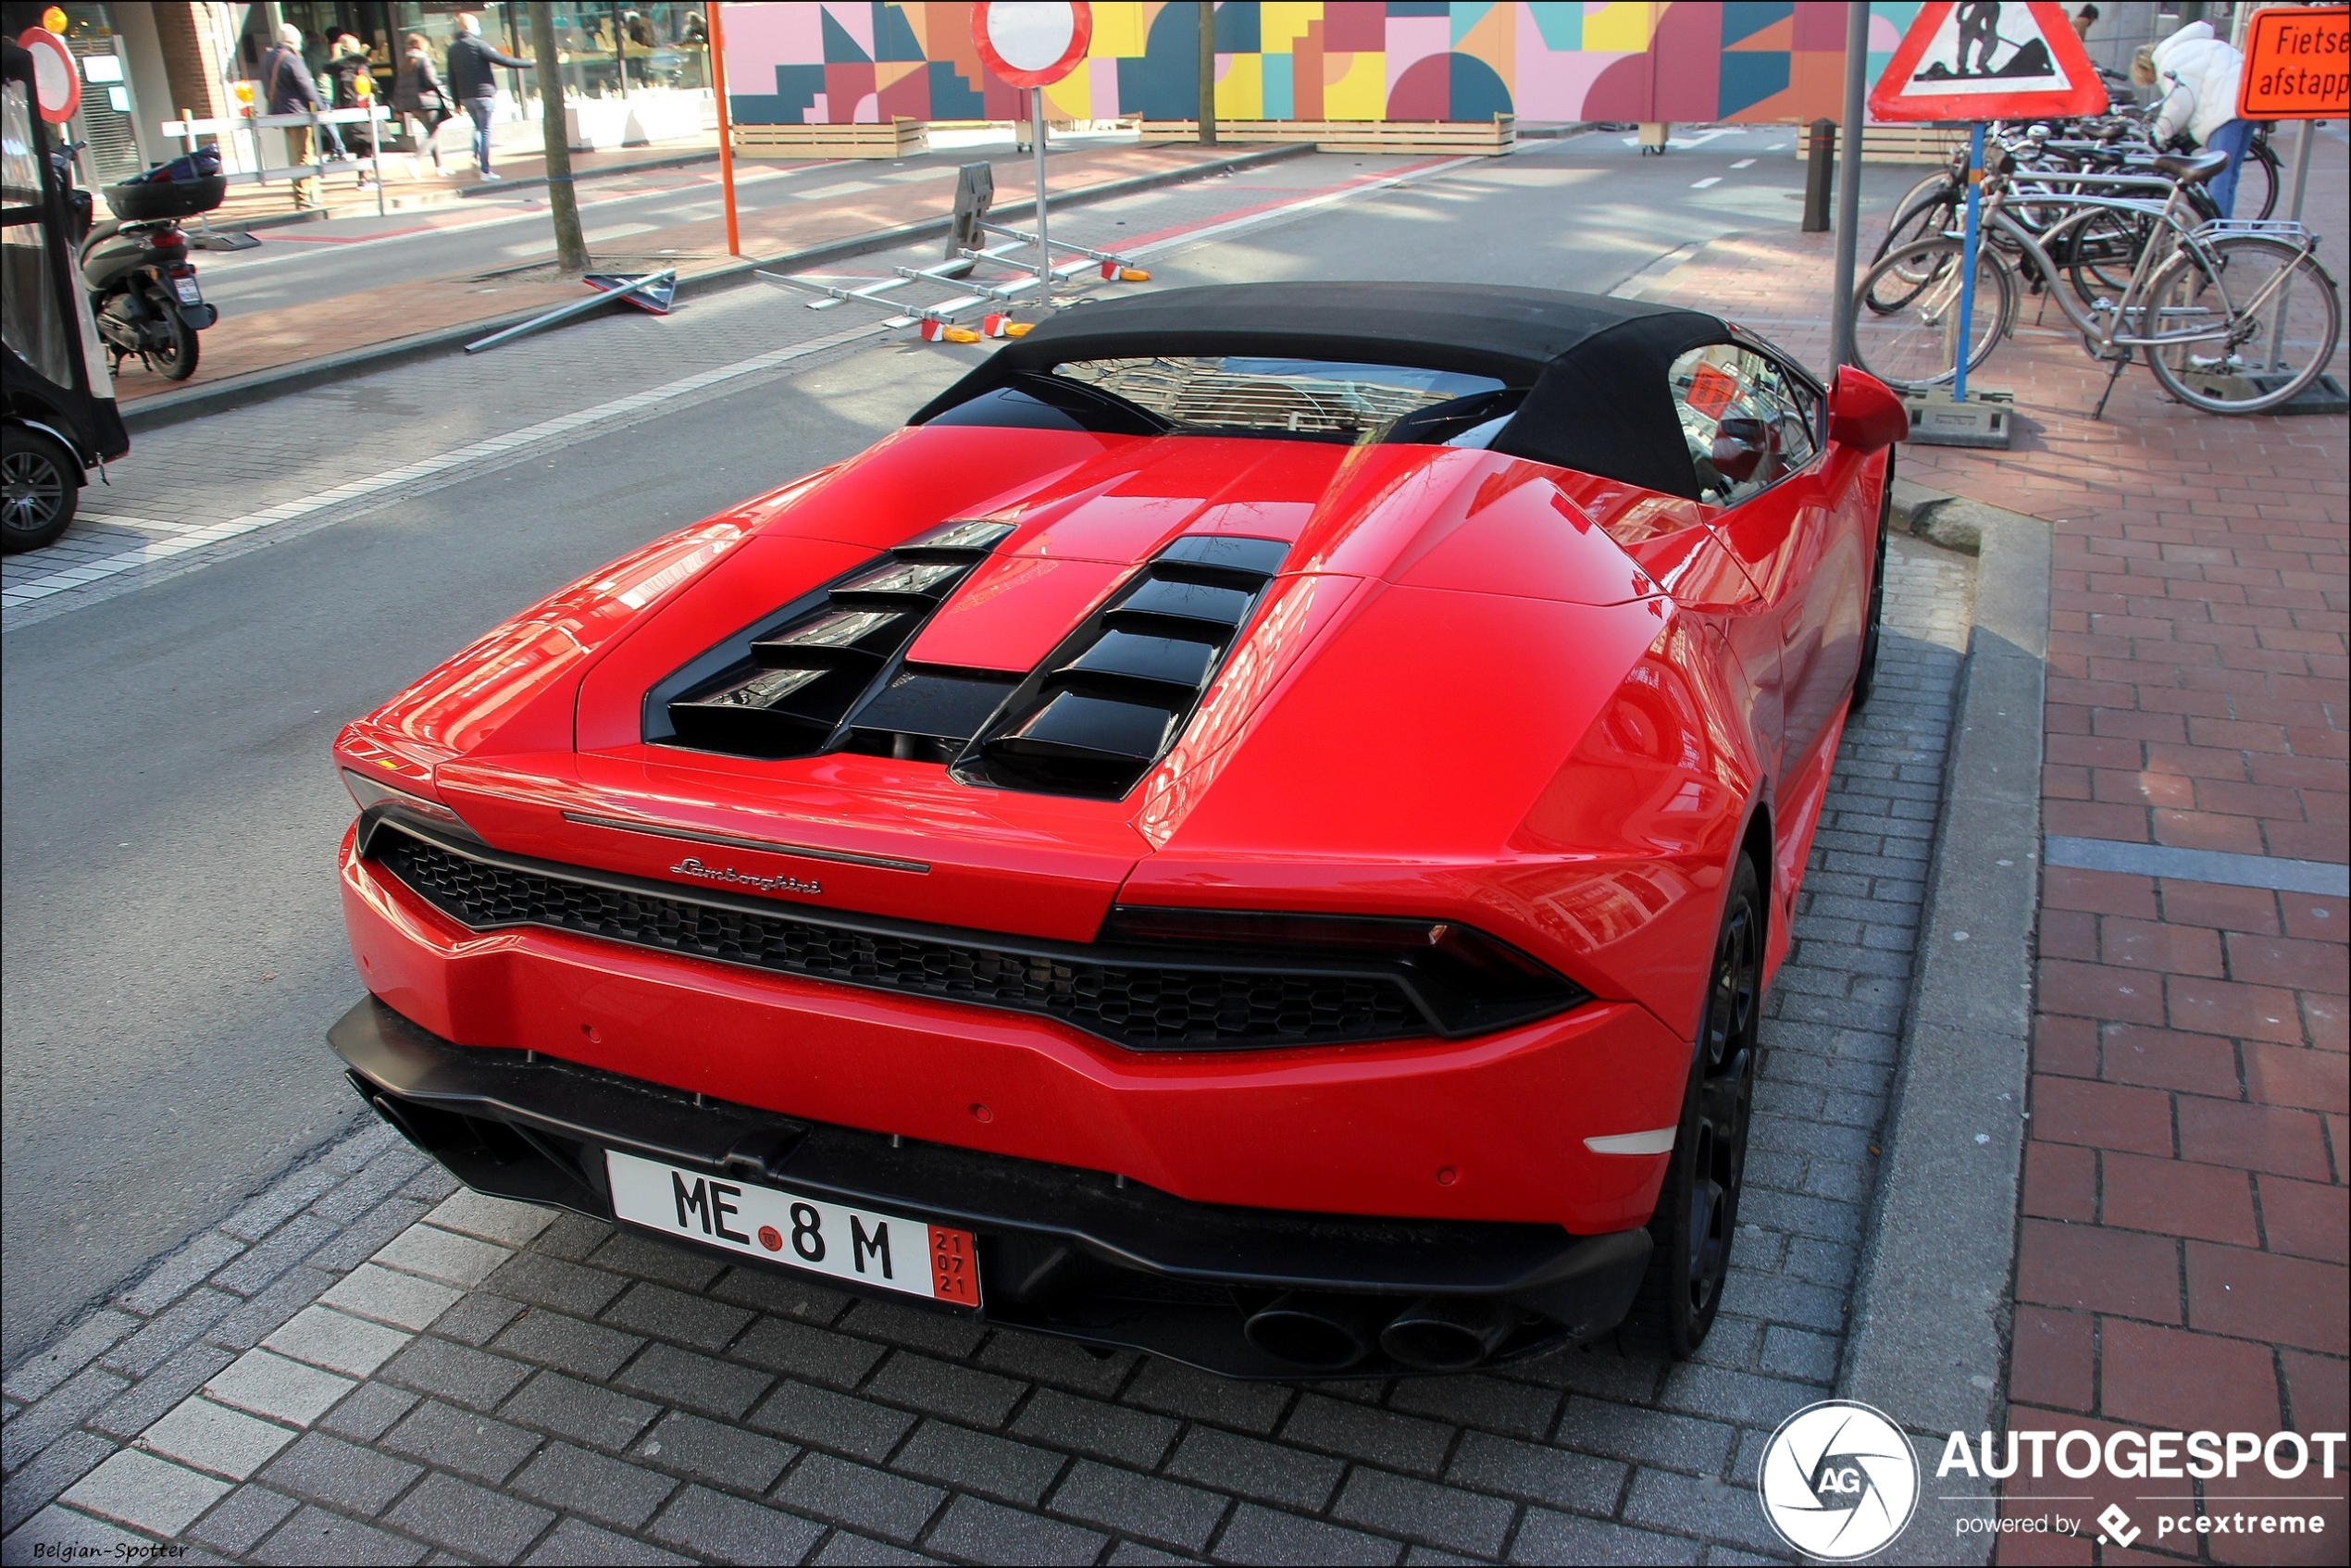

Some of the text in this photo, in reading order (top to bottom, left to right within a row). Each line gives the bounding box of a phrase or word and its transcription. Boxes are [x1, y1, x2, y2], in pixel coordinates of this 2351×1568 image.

[2277, 26, 2349, 54] Fietse
[2259, 67, 2349, 102] afstapp
[669, 857, 822, 895] Lamborghini
[671, 1170, 893, 1280] ME 8 M
[935, 1231, 960, 1253] 21
[938, 1252, 963, 1274] 07
[939, 1274, 964, 1294] 21
